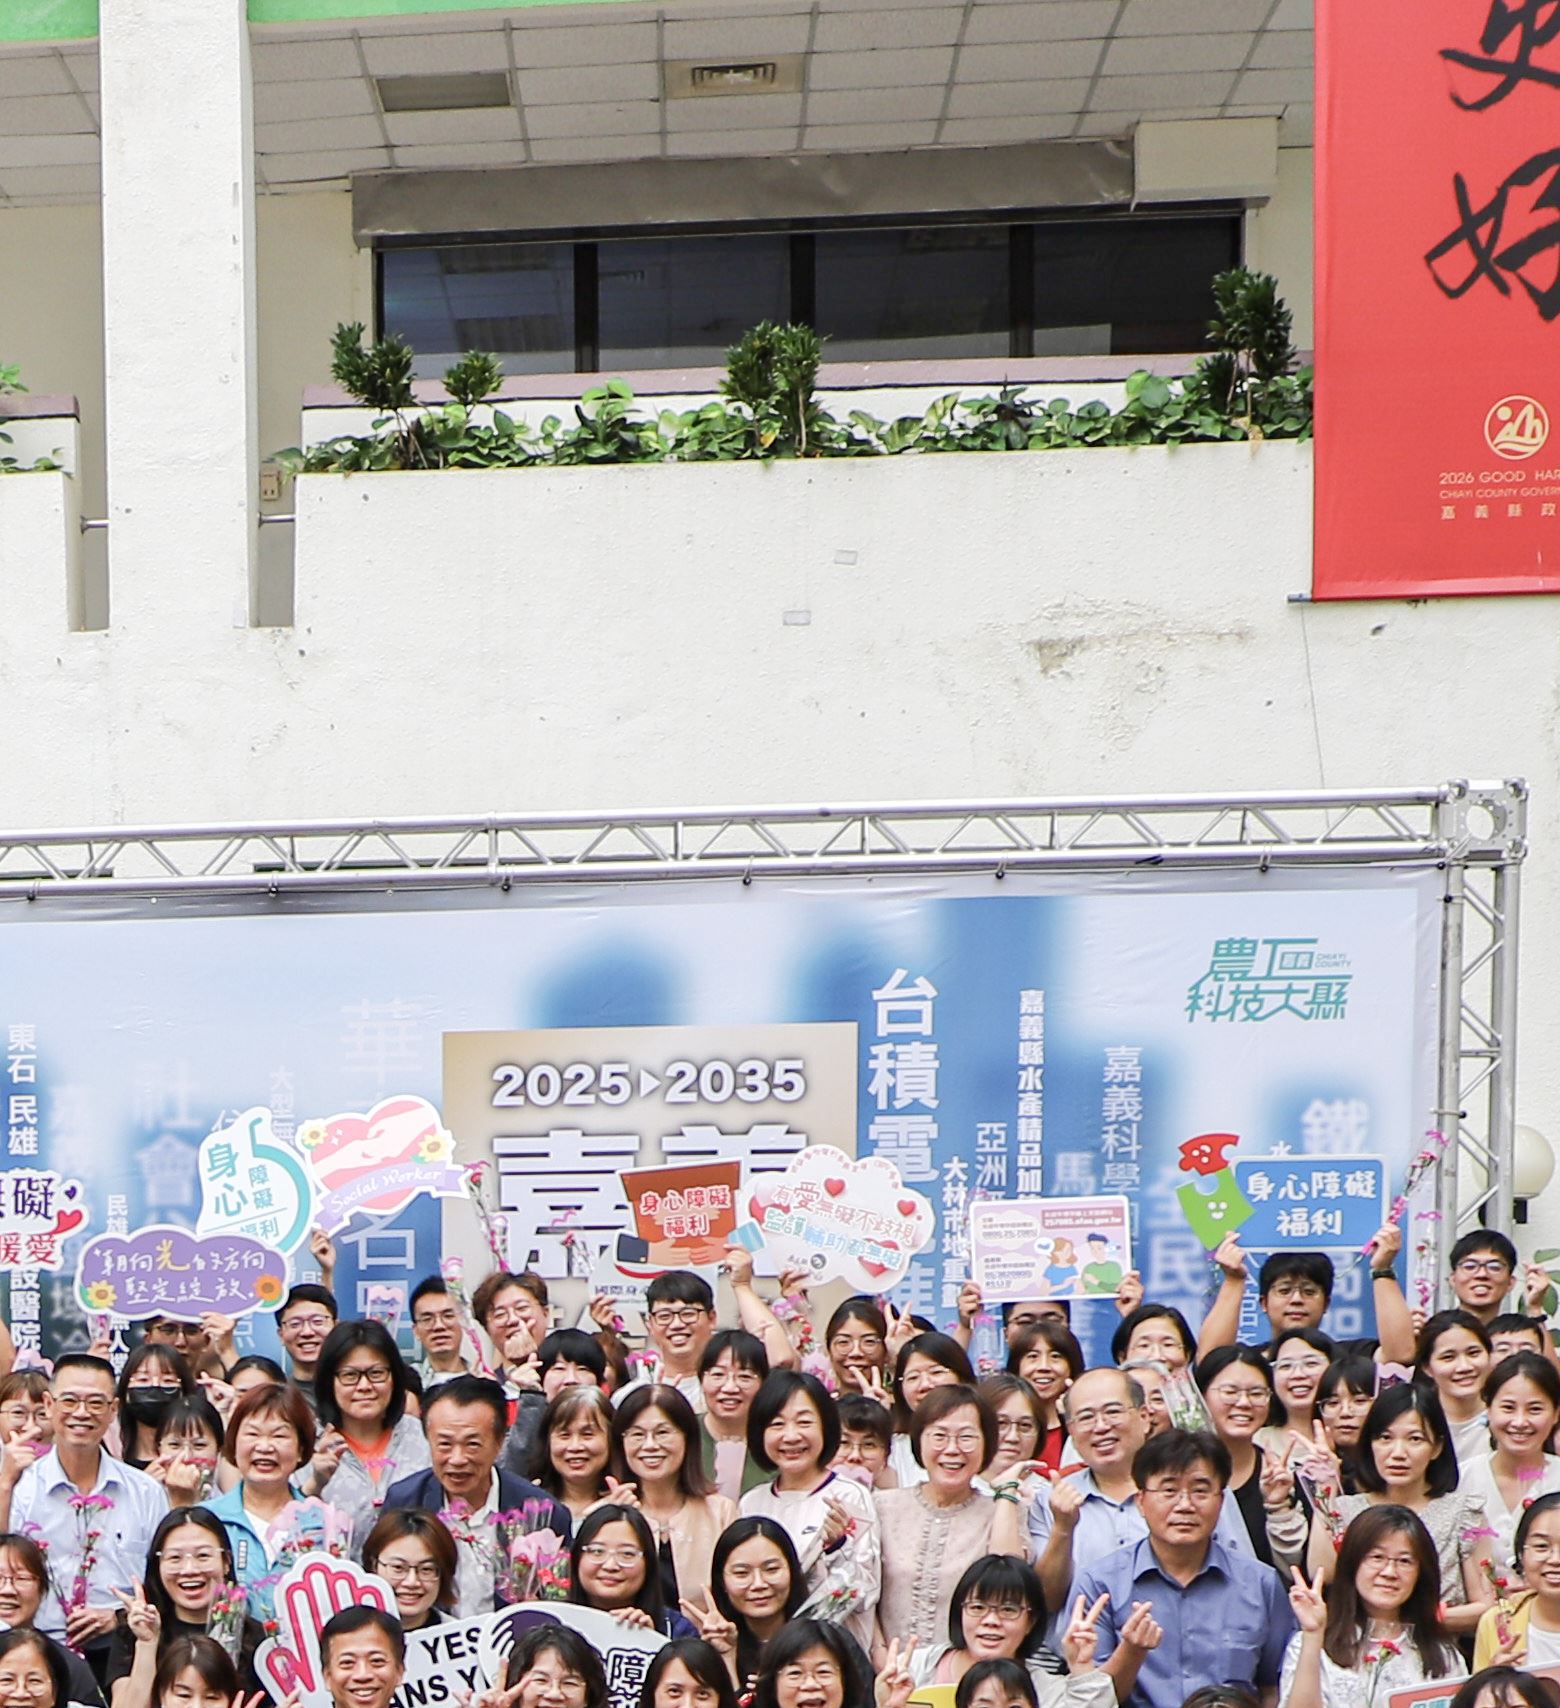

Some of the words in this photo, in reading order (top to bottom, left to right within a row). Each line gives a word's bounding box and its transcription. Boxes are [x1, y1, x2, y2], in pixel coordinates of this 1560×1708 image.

[1439, 472, 1475, 484] 2026
[1479, 471, 1526, 483] GOOD
[1476, 488, 1518, 498] COUNTY
[1184, 982, 1350, 1023] 科技大縣
[492, 1063, 632, 1107] 2025
[664, 1059, 807, 1102] 2035
[1017, 989, 1045, 1199] 嘉義縣水產精品加
[330, 1180, 380, 1214] Social
[382, 1166, 442, 1186] Worker
[641, 1186, 730, 1214] 身心障礙
[1246, 1170, 1377, 1203] 身心障礙
[665, 1213, 710, 1237] 福利
[773, 1181, 915, 1246] 有愛無礙不歧視
[1276, 1208, 1343, 1238] 福利
[421, 1627, 481, 1664] YES
